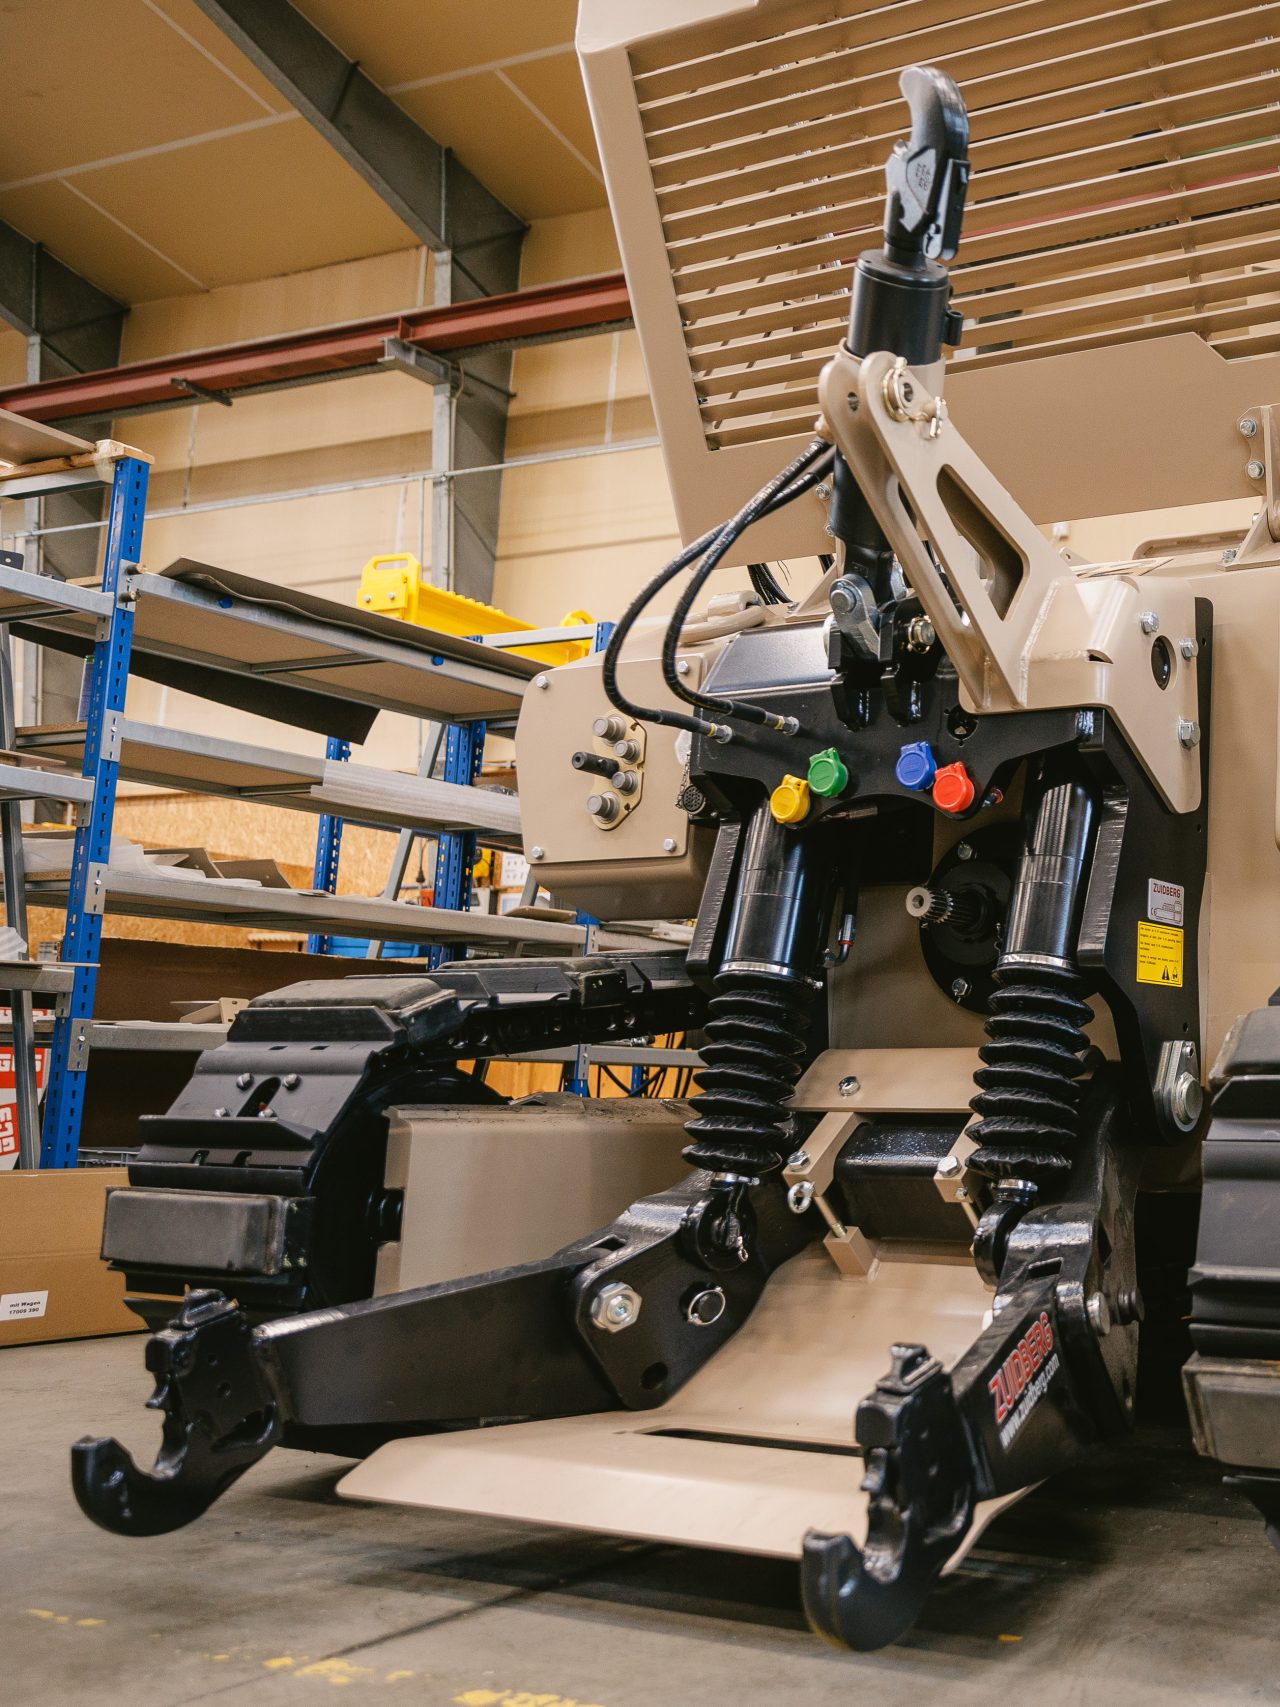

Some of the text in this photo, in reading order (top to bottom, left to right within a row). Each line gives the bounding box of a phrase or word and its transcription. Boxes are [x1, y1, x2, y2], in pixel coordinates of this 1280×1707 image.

[1153, 882, 1181, 898] ZUIDBERG
[987, 1311, 1054, 1425] ZUIDBERG
[999, 1353, 1061, 1450] www.zuidberg.com
